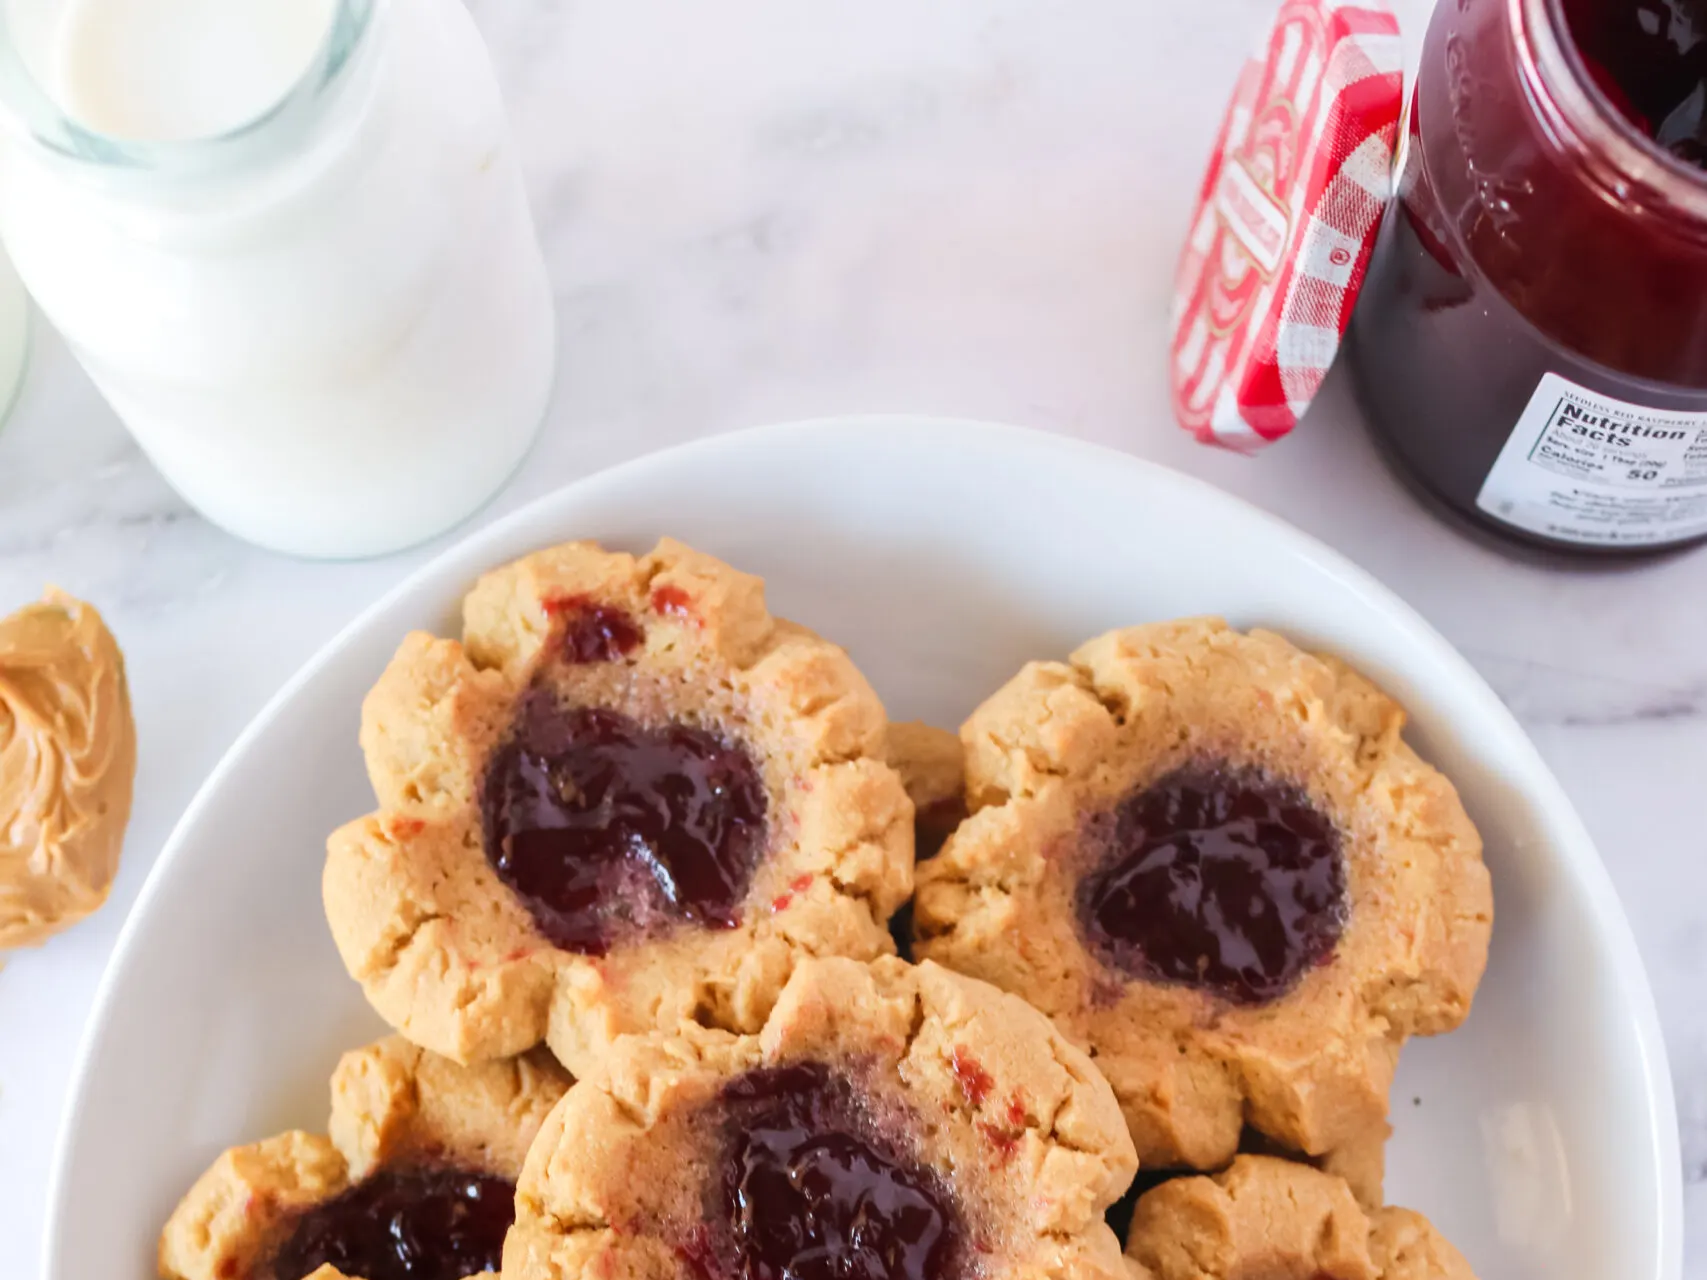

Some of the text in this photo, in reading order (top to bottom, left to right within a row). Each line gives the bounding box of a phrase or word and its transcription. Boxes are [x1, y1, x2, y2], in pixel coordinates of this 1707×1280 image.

[1563, 403, 1687, 440] Nutrition
[1614, 410, 1634, 419] RED
[1557, 416, 1632, 447] Facts
[1541, 446, 1604, 470] Calories
[1627, 470, 1658, 480] 50
